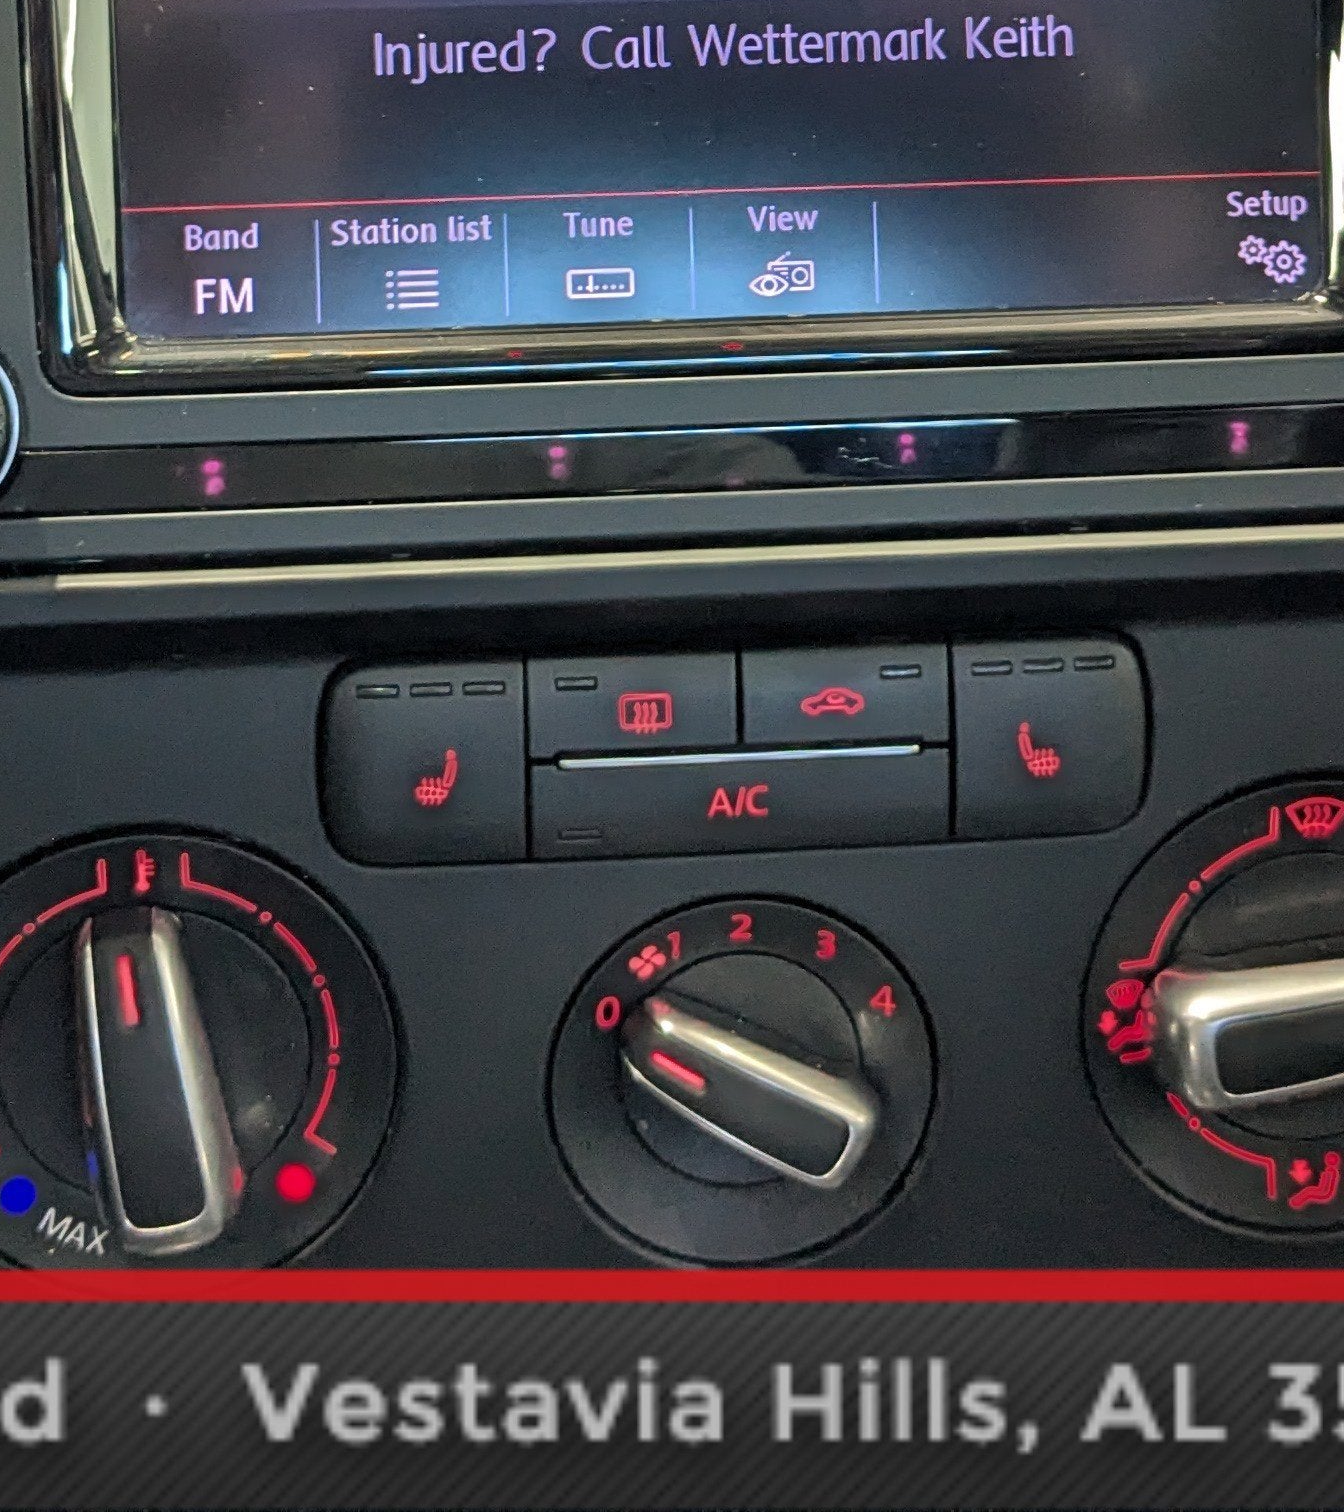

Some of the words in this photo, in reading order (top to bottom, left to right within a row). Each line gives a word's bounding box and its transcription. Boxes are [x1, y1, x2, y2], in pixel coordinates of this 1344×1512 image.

[373, 27, 557, 85] Injured?
[581, 24, 672, 70] Call
[686, 17, 947, 67] Wettermark
[965, 14, 1074, 60] Keith
[746, 205, 820, 235] View
[1225, 189, 1308, 222] Setup
[182, 222, 260, 252] Band
[328, 216, 439, 248] Station
[446, 213, 494, 245] list
[562, 210, 635, 240] Tune
[195, 277, 254, 315] FM
[707, 783, 768, 818] A/C
[595, 995, 622, 1030] 0
[663, 931, 681, 964] 1
[729, 913, 753, 942] 2
[816, 928, 837, 959] 3
[869, 984, 897, 1016] 4
[36, 1206, 110, 1256] MAX
